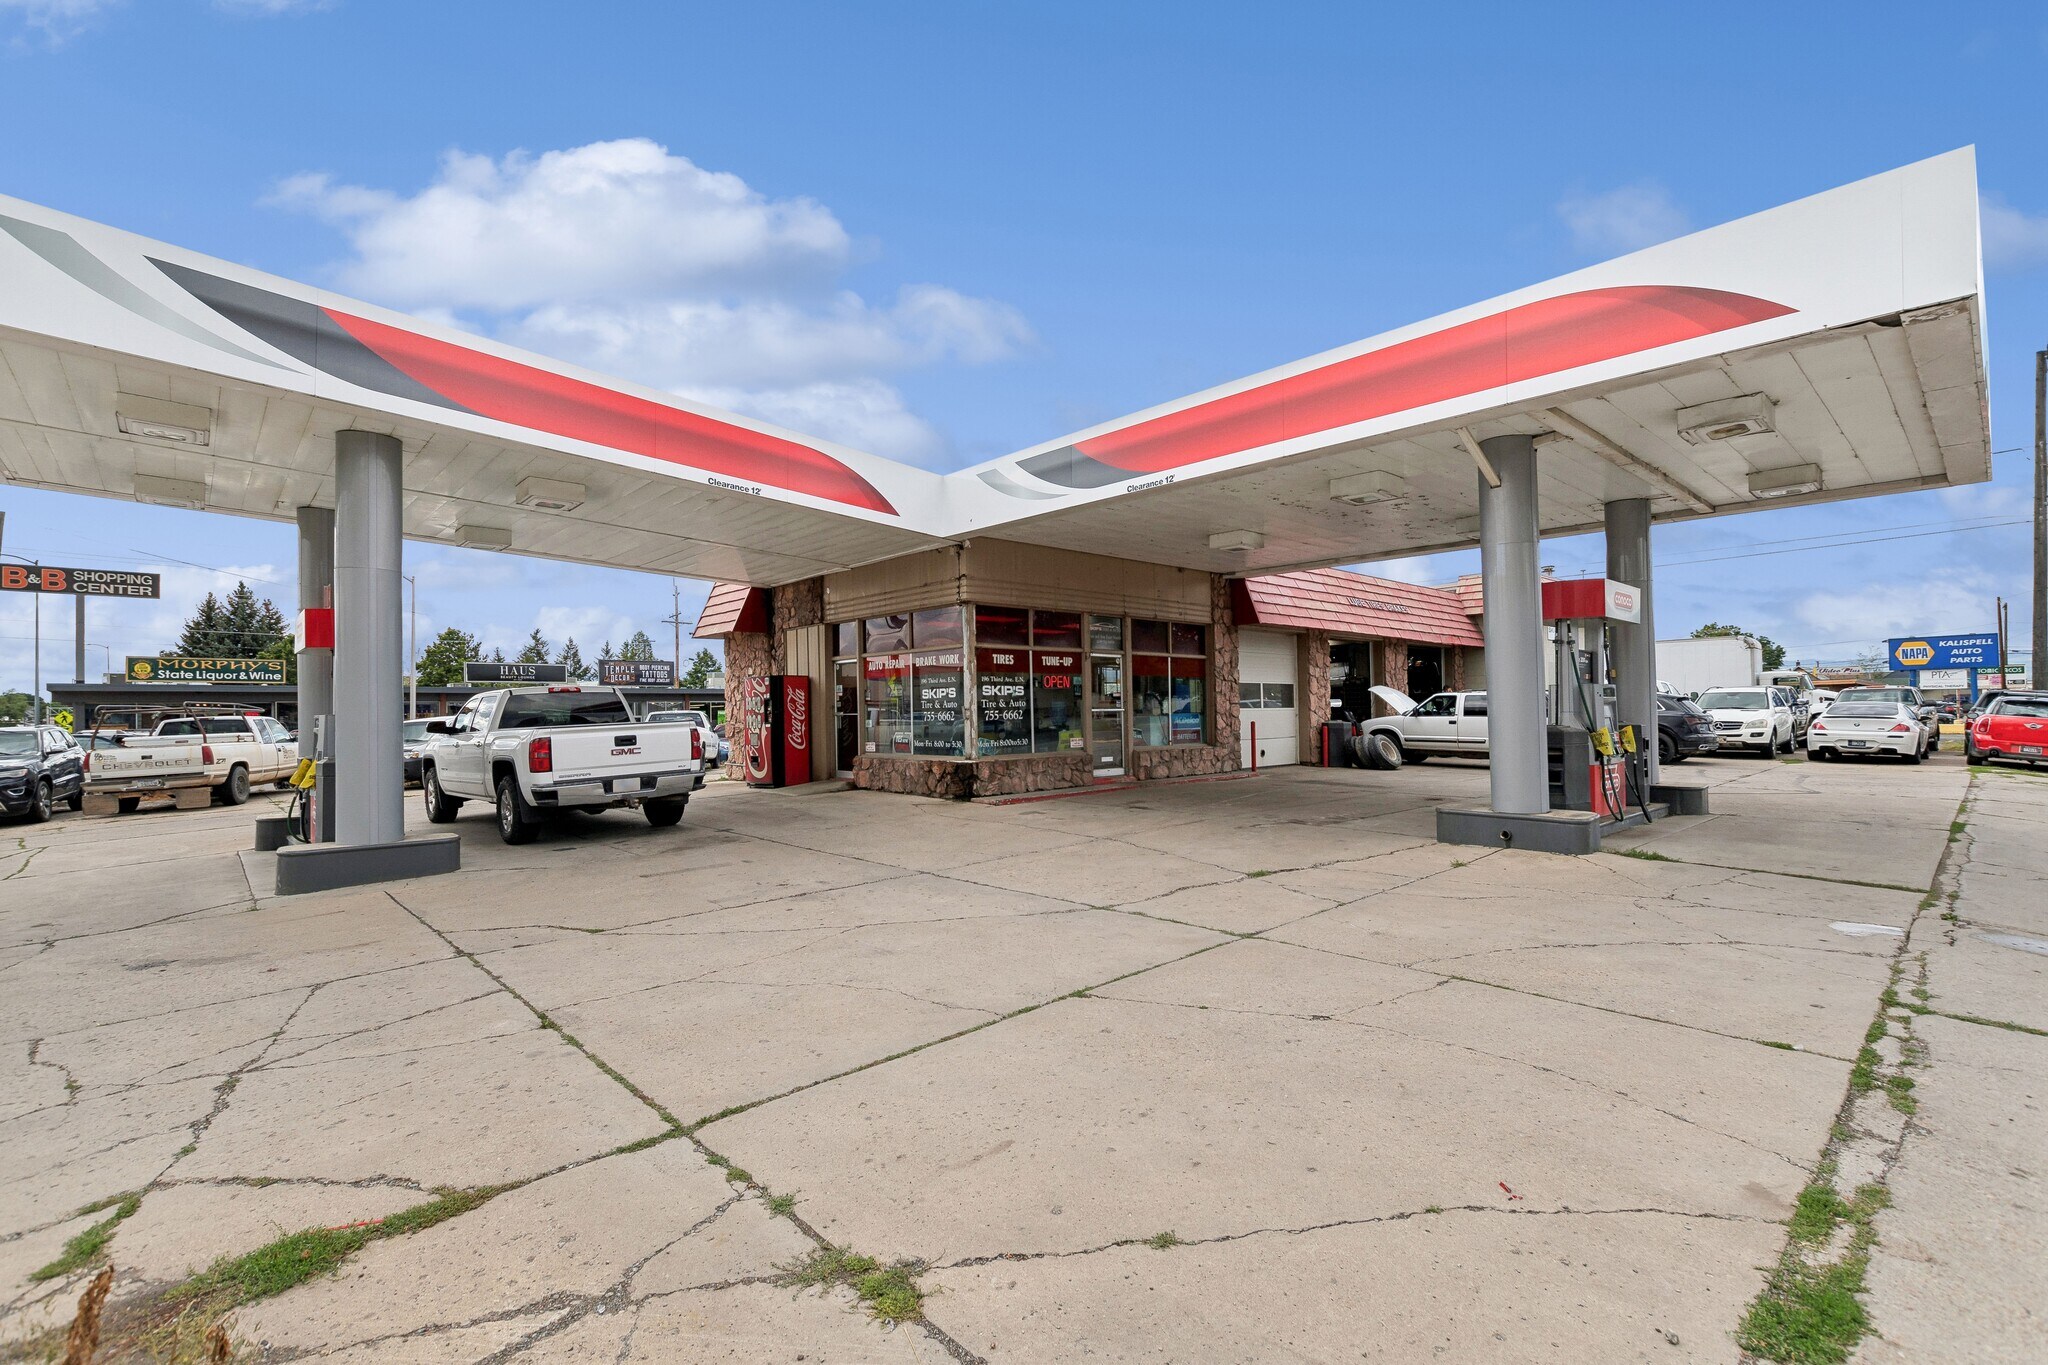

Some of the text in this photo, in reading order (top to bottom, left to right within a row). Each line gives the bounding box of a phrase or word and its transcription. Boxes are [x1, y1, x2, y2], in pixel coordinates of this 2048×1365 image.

[708, 478, 750, 492] Clearance
[1126, 479, 1164, 492] Clearance
[2, 566, 67, 591] B&B
[73, 570, 152, 585] SHOPPING
[73, 582, 152, 596] CENTER
[1939, 638, 1993, 647] KALISPELL
[1901, 648, 1929, 659] NAPA
[157, 659, 281, 671] MURPHY'S
[868, 659, 905, 671] AUTO REPAIR
[915, 654, 959, 667] BRAKE WORK
[992, 654, 1014, 665] TIRES
[1042, 656, 1073, 666] TUNE-UP
[158, 670, 194, 679] State
[196, 670, 238, 680] Liquor
[249, 672, 282, 680] Wine
[500, 666, 536, 675] HAUS
[605, 665, 635, 676] TEMPLE
[1044, 675, 1070, 688] OPEN
[922, 688, 956, 699] SKIP'S
[982, 685, 1024, 696] SKIP'S
[921, 701, 933, 709] Tire
[943, 700, 957, 708] Auto
[981, 700, 996, 708] Tire
[999, 699, 1006, 707] &
[924, 711, 955, 722] 755-6662
[984, 710, 1023, 721] 755-6662
[611, 747, 641, 756] GMC
[102, 758, 192, 770] CHEVROLET
